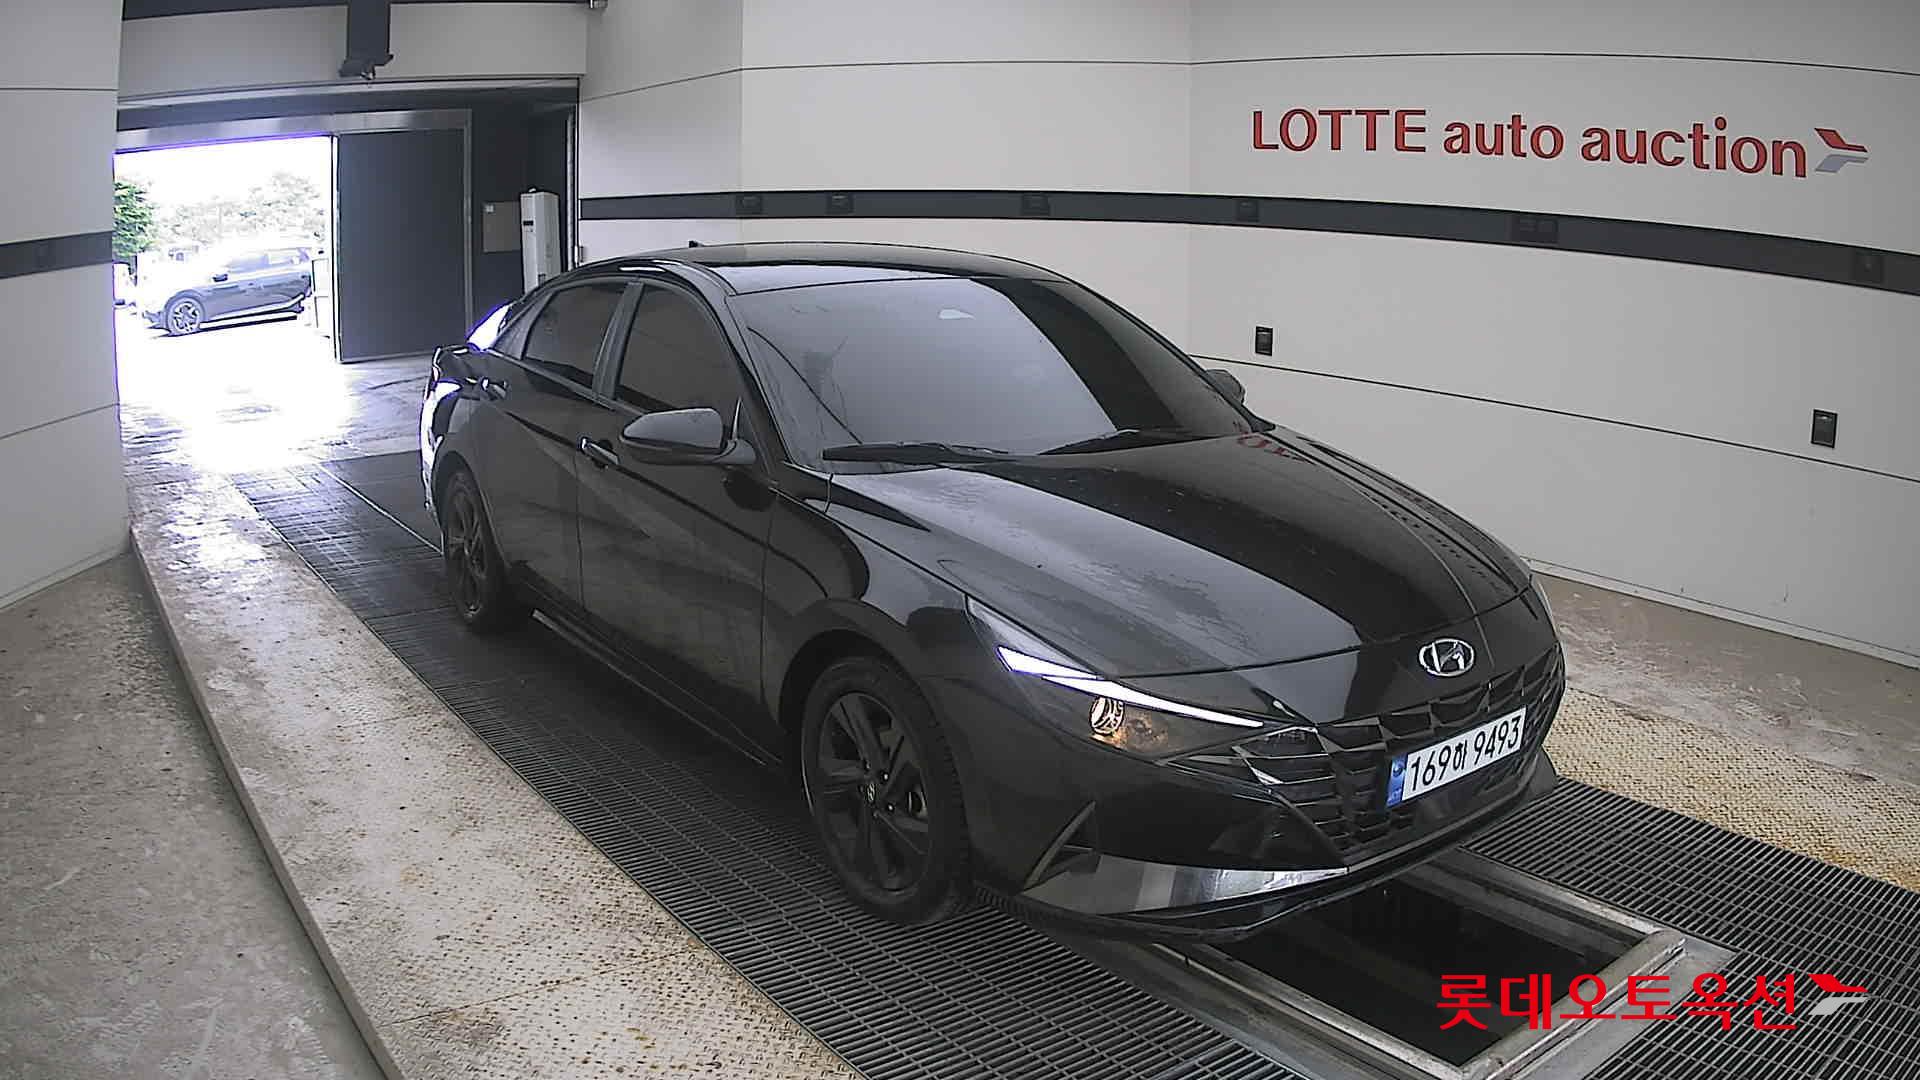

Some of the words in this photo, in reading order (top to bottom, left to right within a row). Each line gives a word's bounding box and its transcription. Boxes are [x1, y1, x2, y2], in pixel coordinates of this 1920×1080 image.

[1252, 108, 1427, 153] LOTTE
[1442, 114, 1565, 159] auto
[1581, 116, 1808, 178] auction
[1473, 715, 1522, 765] 9493
